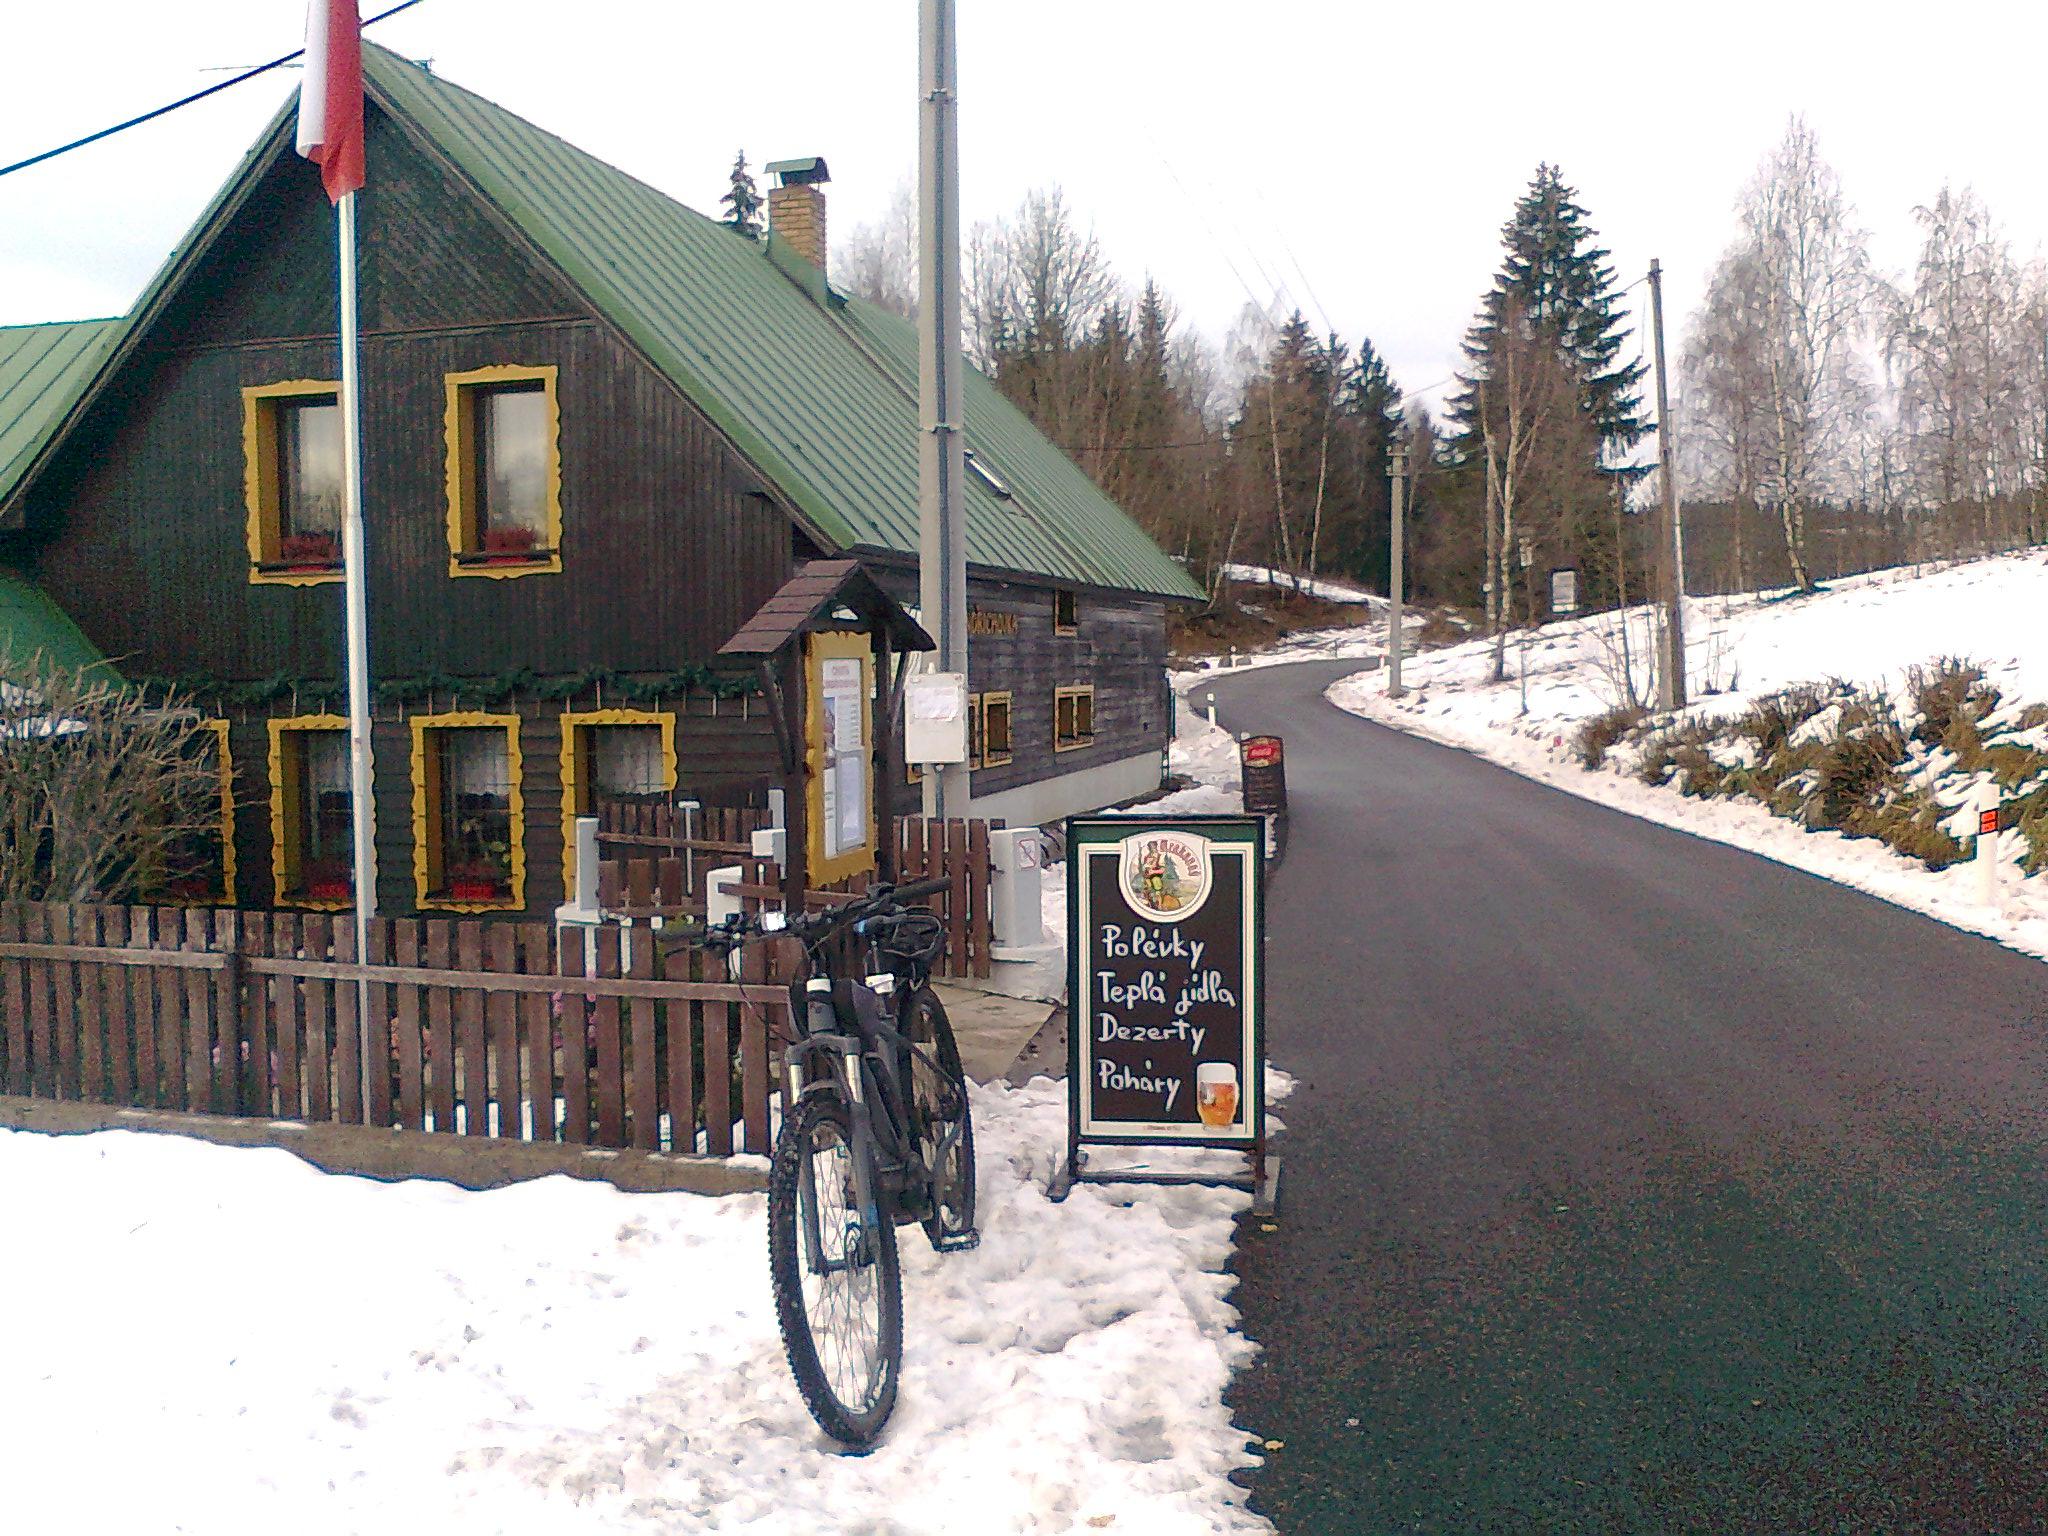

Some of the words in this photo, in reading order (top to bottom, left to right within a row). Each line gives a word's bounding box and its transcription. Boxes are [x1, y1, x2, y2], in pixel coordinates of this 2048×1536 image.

[1101, 924, 1205, 970] Polévky
[1097, 970, 1166, 1010] Teplá
[1175, 969, 1236, 1016] jídla
[1097, 1012, 1205, 1056] Dezerty
[1098, 1058, 1181, 1112] Poháry
